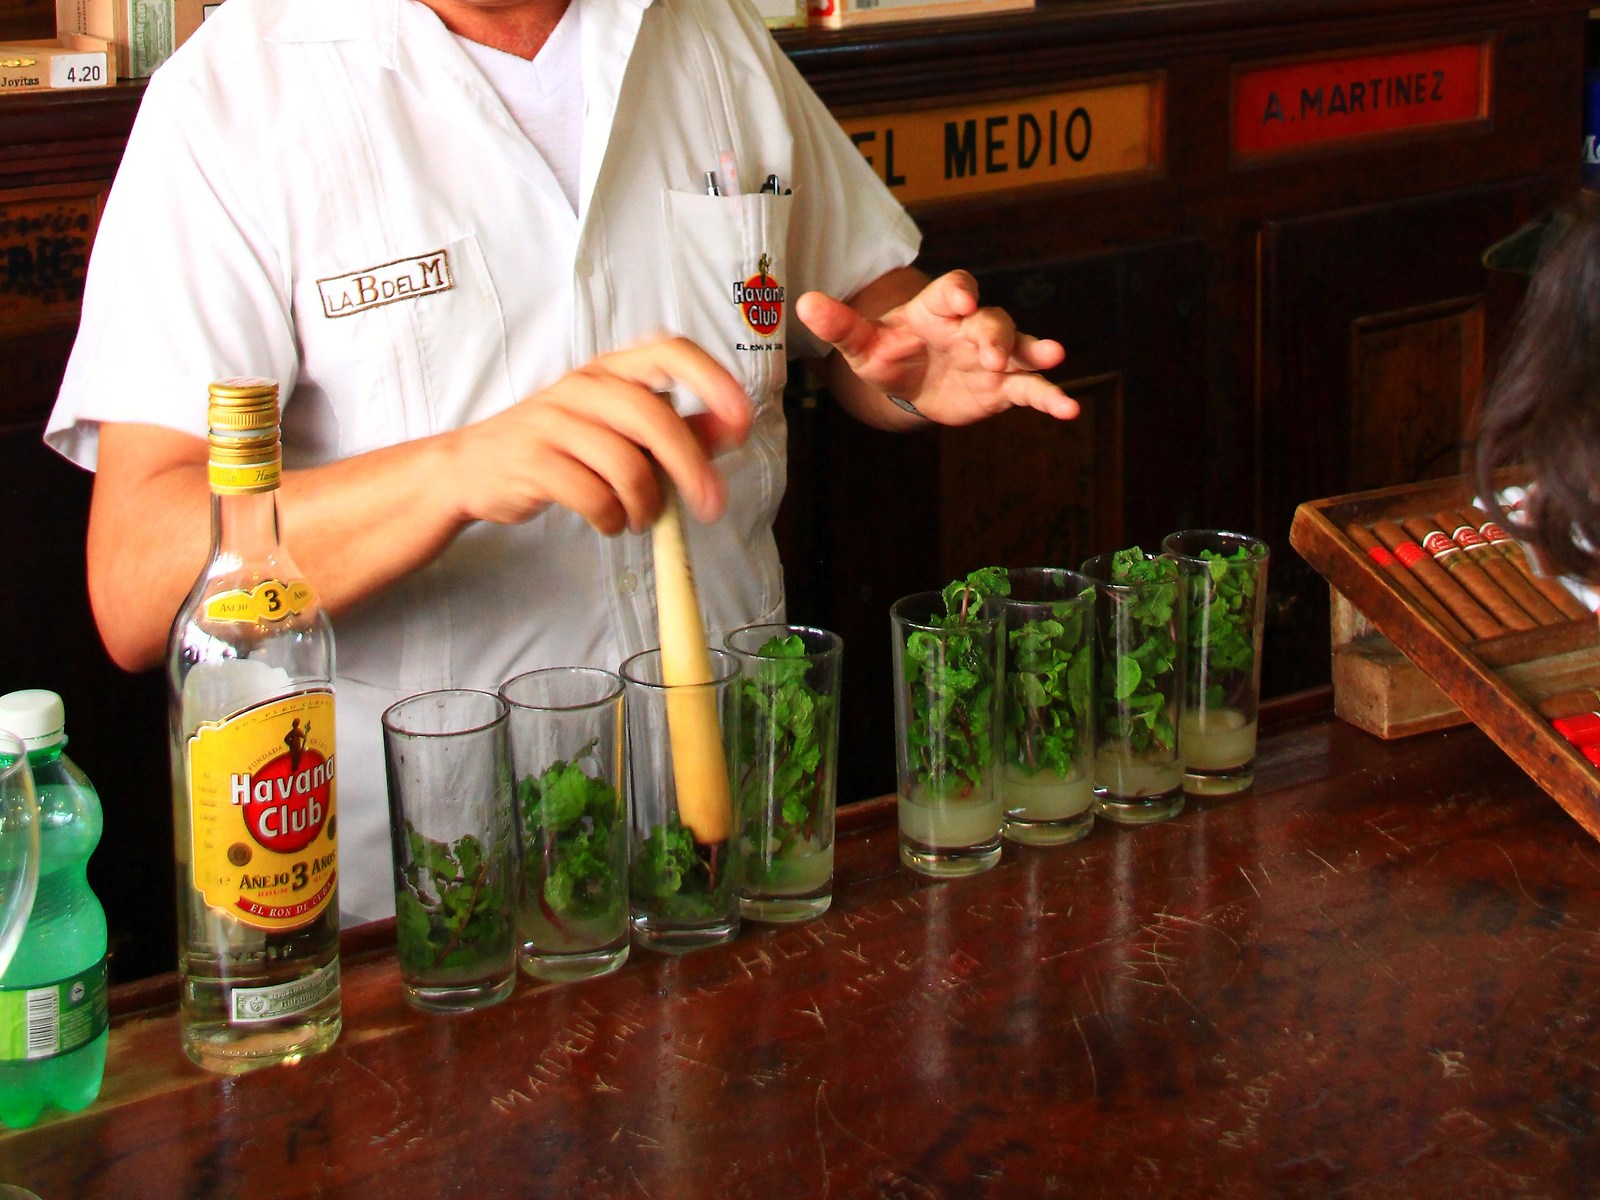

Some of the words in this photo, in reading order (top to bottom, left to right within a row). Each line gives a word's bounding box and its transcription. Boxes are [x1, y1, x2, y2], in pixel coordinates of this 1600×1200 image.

[1, 76, 40, 88] Joyitas
[67, 65, 101, 83] 4.20
[943, 105, 1093, 181] MEDIO
[733, 281, 785, 305] Havana
[748, 304, 779, 327] Club
[264, 588, 282, 613] 3
[247, 744, 284, 771] FUNDADA
[230, 754, 336, 806] Havana
[258, 796, 323, 839] Club
[239, 872, 290, 890] AÑEJO
[291, 861, 309, 893] 3
[250, 903, 265, 915] EL
[269, 906, 292, 918] RON
[296, 902, 309, 915] DE
[312, 881, 333, 906] CUBA
[257, 887, 288, 898] RHUM
